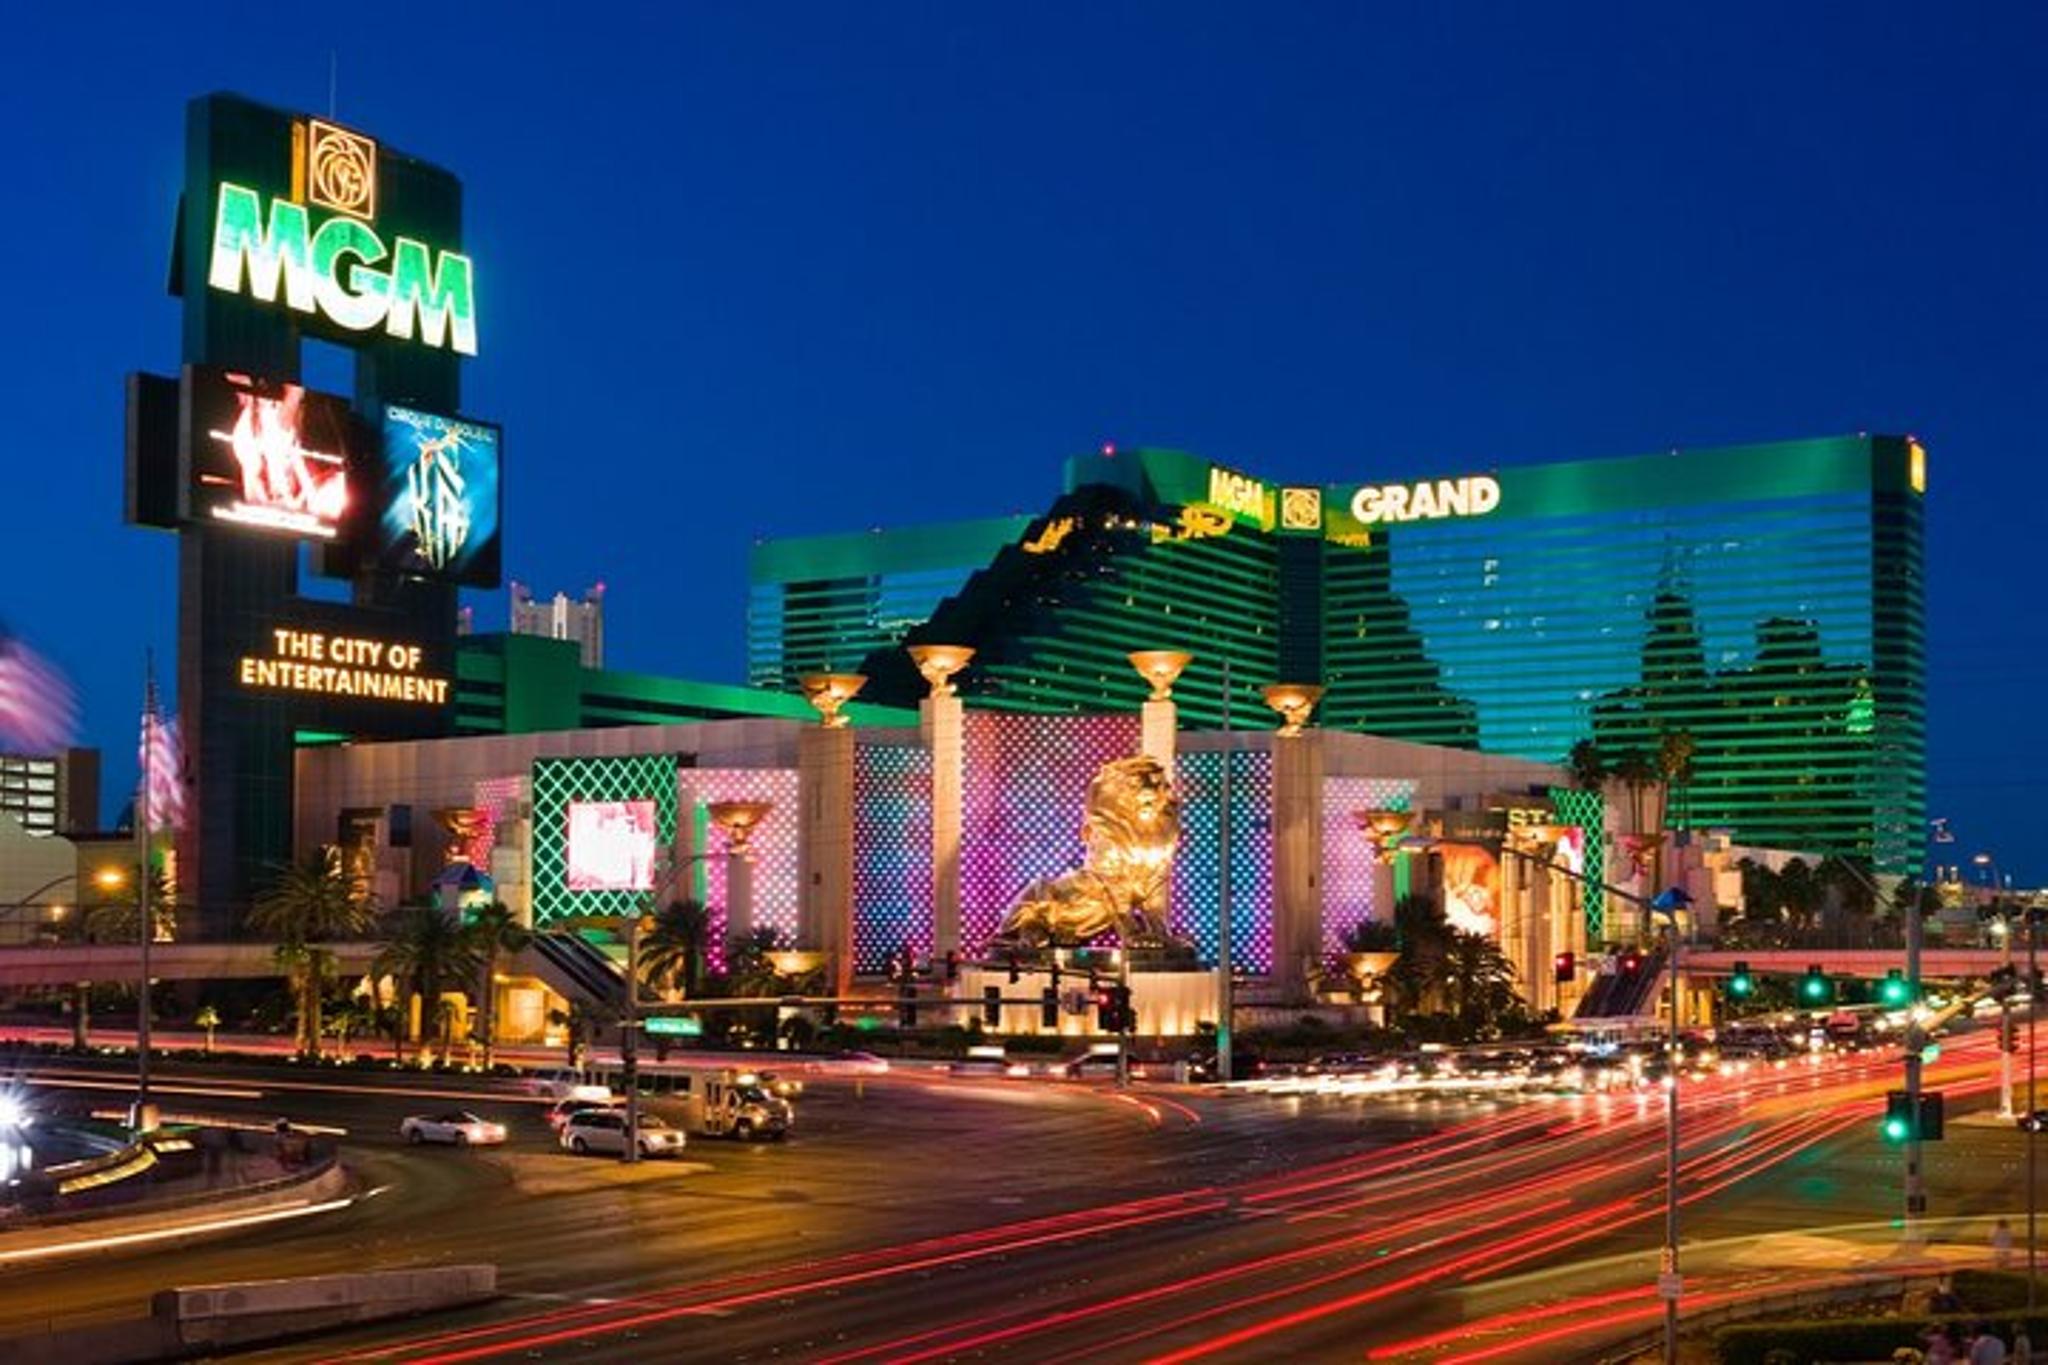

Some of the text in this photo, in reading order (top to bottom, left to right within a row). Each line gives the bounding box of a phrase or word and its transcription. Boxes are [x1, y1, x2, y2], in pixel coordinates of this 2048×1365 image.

[208, 181, 479, 356] MGM
[1209, 467, 1500, 526] MGM GRAND
[274, 630, 422, 670] THE CITY OF
[240, 658, 449, 704] ENTERTAINMENT
